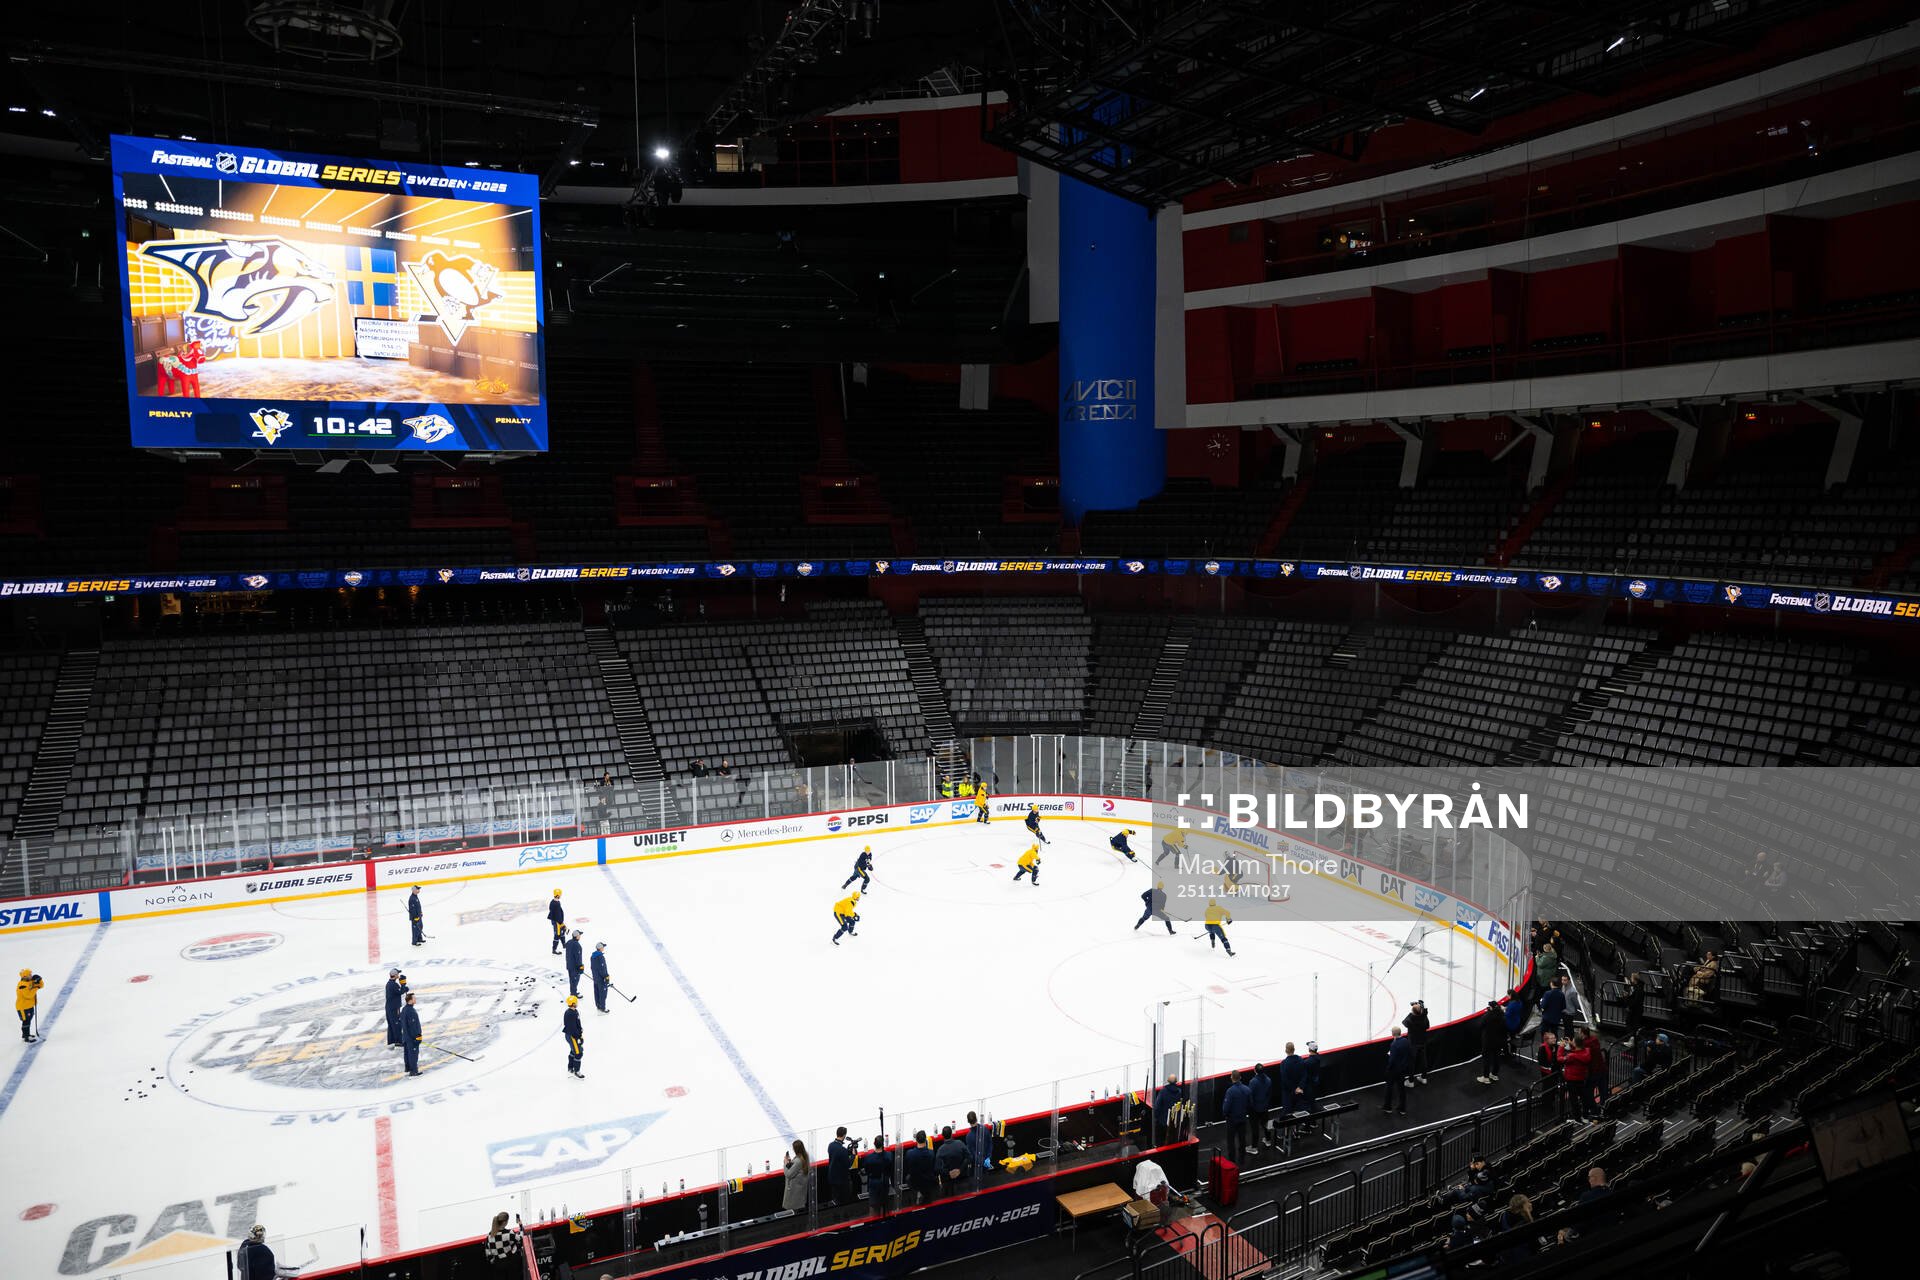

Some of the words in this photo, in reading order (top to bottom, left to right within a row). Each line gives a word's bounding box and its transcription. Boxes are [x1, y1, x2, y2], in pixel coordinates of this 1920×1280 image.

[239, 156, 320, 179] GLOBAL
[321, 165, 401, 186] SERIES
[149, 410, 192, 418] PENALTY
[313, 417, 393, 435] 10:42
[480, 571, 516, 580] FASTENAL
[531, 568, 578, 580] GLOBAL
[579, 567, 629, 578] SERIES
[911, 563, 942, 571] FASTENAL
[956, 561, 998, 571] GLOBAL
[999, 561, 1044, 571] SERIES
[1317, 567, 1349, 577] FASTENAL
[1362, 567, 1404, 580] GLOBAL
[1405, 570, 1453, 582] SERIES
[1, 582, 64, 595] GLOBAL
[66, 580, 130, 592] SERIES
[1769, 593, 1812, 607] FASTENAL
[1831, 596, 1893, 615] GLOBAL
[911, 807, 935, 821] SAP
[952, 802, 975, 816] SAP
[848, 813, 889, 827] PEPSI
[633, 831, 687, 847] UNIBET
[737, 824, 804, 839] Mercedes-Benz
[388, 865, 430, 876] SWEDEN
[433, 862, 459, 871] 2025
[1340, 859, 1364, 885] CAT
[259, 878, 304, 892] GLOBAL
[306, 873, 353, 886] SERIES
[1381, 873, 1406, 901] CAT
[145, 892, 213, 906] NORQAIN
[1415, 889, 1440, 910] SAP
[271, 1083, 480, 1126] SWEDEN
[490, 1126, 633, 1177] SAP
[57, 1184, 277, 1276] CAT
[830, 1229, 922, 1271] SERIES
[923, 1218, 995, 1243] SWEDEN
[1000, 1203, 1040, 1224] 2025
